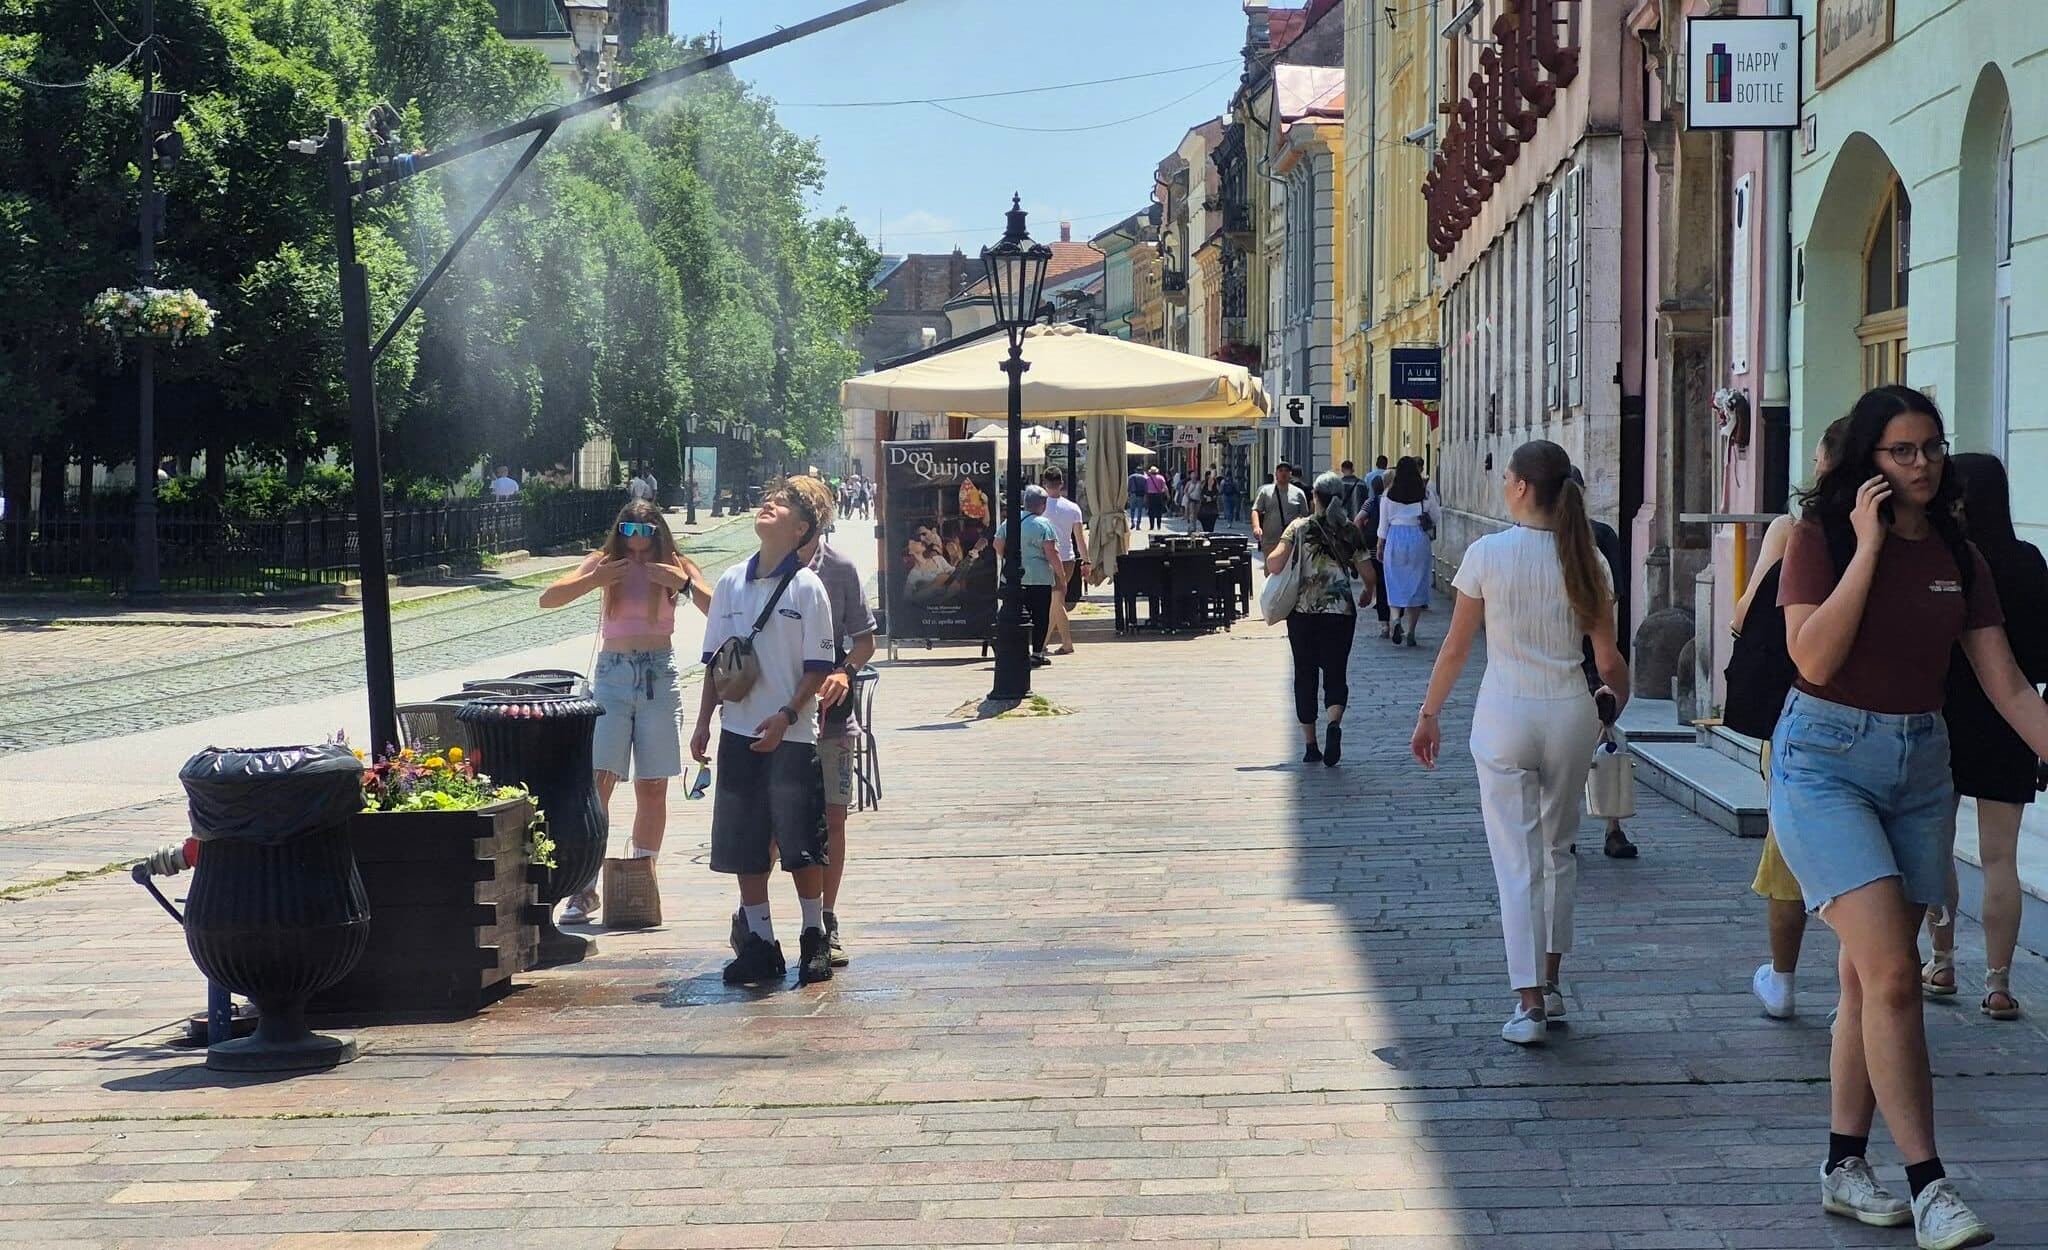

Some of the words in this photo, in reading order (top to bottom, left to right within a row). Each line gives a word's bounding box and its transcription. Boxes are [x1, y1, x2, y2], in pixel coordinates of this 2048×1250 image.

[1737, 52, 1779, 72] HAPPY
[1737, 83, 1784, 103] BOTTLE
[1179, 431, 1194, 440] dm
[889, 447, 934, 465] Don
[914, 457, 990, 480] Quijote
